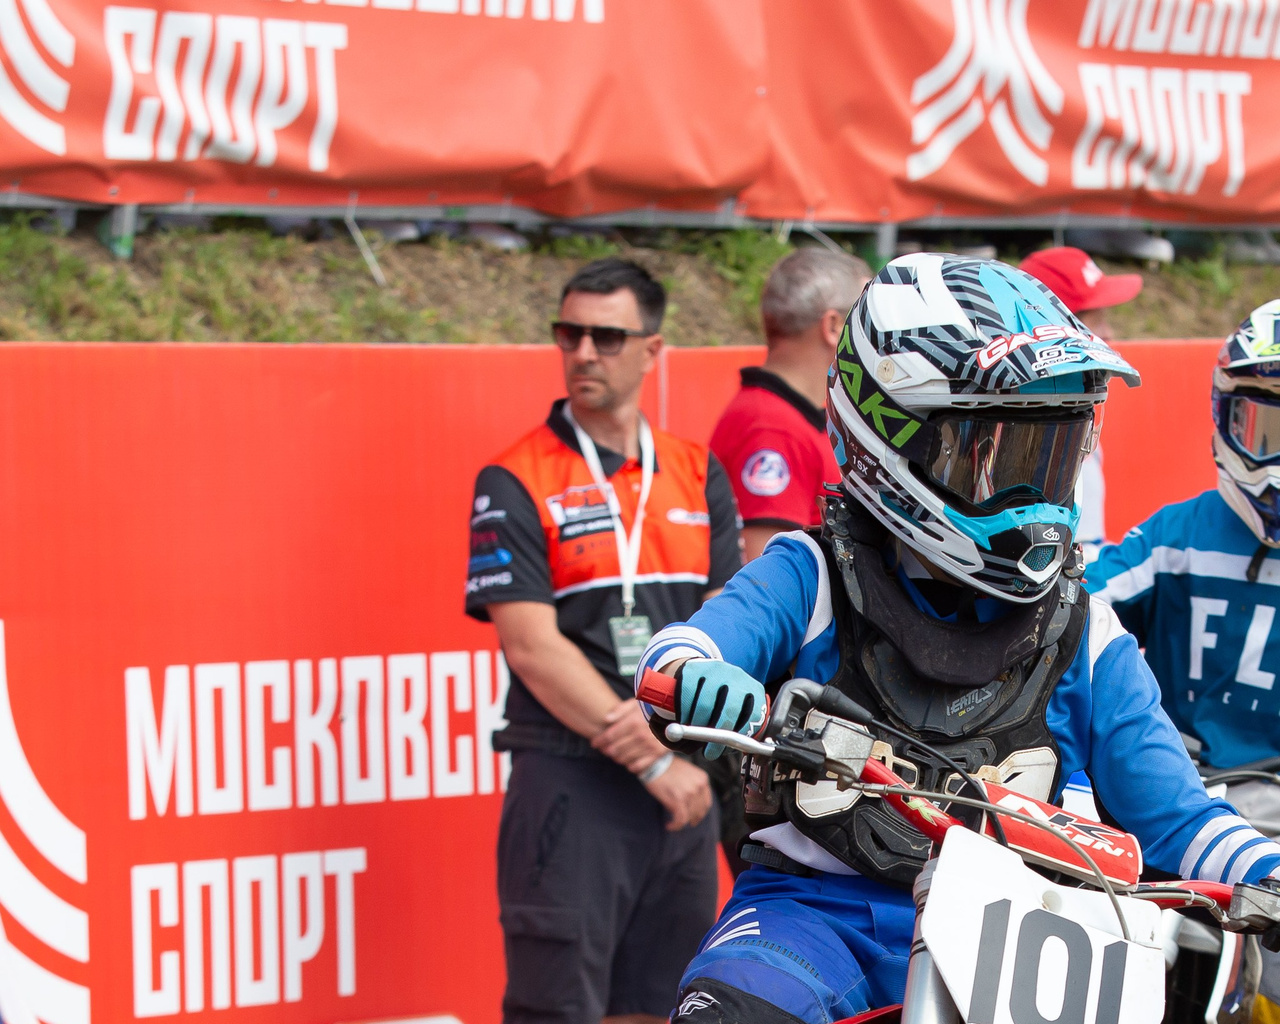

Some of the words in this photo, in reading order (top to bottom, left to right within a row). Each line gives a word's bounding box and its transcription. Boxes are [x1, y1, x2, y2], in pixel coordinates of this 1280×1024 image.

[102, 7, 348, 171] СПОРТ
[1072, 63, 1252, 196] СПОРТ
[125, 649, 512, 820] МОСКОВСК
[131, 847, 367, 1018] СПОРТ
